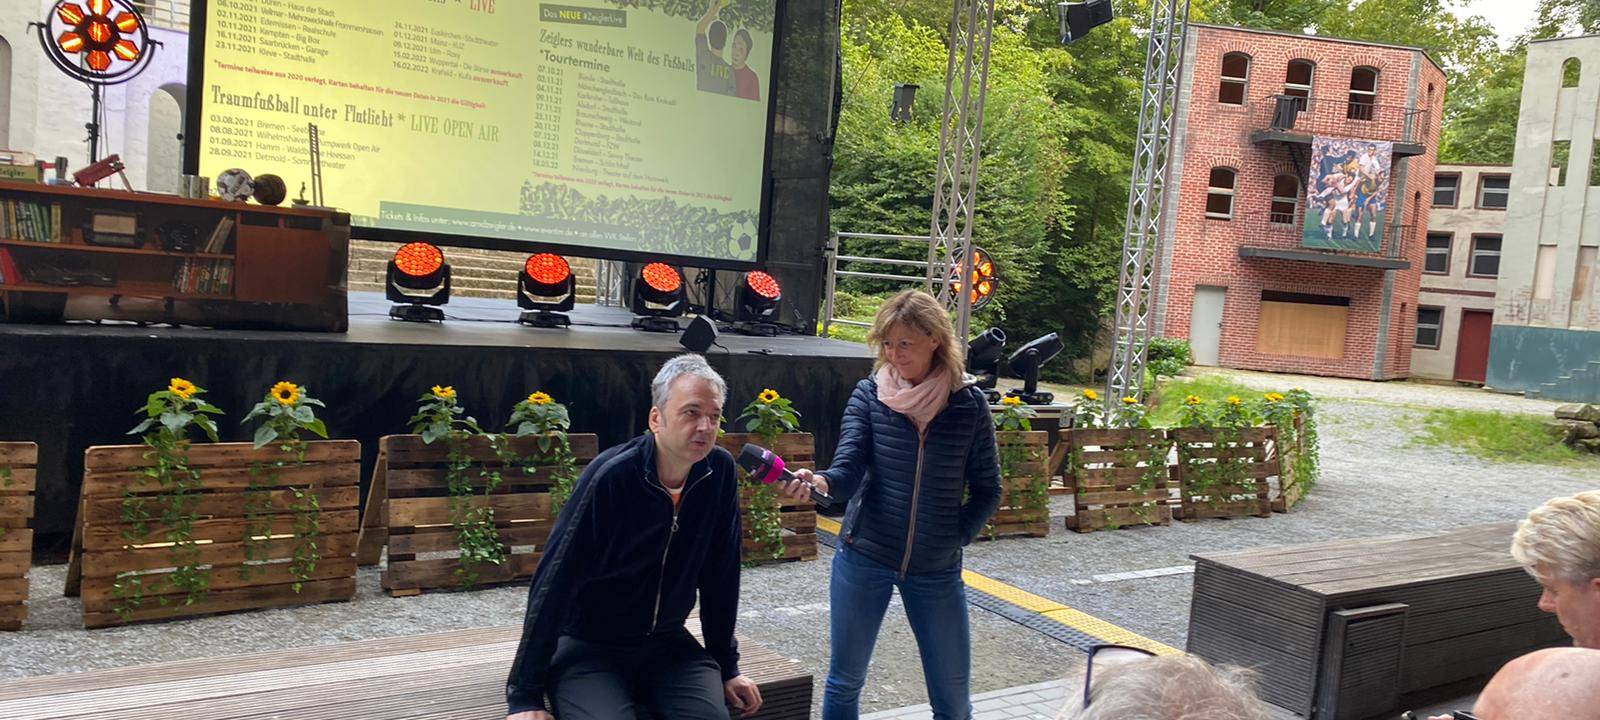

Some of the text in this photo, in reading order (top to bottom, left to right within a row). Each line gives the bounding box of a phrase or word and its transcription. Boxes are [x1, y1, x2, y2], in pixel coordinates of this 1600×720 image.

[216, 9, 257, 23] 02.11.2021
[287, 2, 304, 12] Haus
[305, 6, 317, 14] der
[318, 7, 335, 17] Stadt
[543, 9, 558, 19] Das
[559, 10, 582, 20] NEUE
[217, 20, 257, 33] 10.11.2021
[308, 35, 320, 45] Box
[393, 31, 428, 43] 01.12.2021
[215, 40, 256, 54] 23.11.2021
[259, 47, 277, 58] Kleve
[283, 51, 316, 64] Stadthalle
[259, 37, 300, 51] Saarbrücken
[306, 44, 329, 56] Garage
[393, 40, 427, 53] 09.12.2021
[539, 29, 695, 73] Zeiglers wunderbare Welt des Fußballs
[393, 61, 429, 74] 16.02.2022
[287, 72, 303, 81] 2020
[211, 84, 299, 115] Traumfußball
[303, 103, 337, 120] unter
[344, 103, 393, 127] Flutlicht
[410, 113, 439, 134] LIVE
[443, 117, 474, 139] OPEN
[478, 124, 500, 142] AIR
[210, 114, 253, 127] 03.08.2021
[257, 120, 286, 132] Bremen
[210, 125, 253, 137] 08.08.2021
[317, 138, 352, 151] umpwerk
[353, 142, 370, 153] Open
[371, 145, 380, 154] Air
[209, 136, 252, 149] 01.09.2021
[256, 142, 281, 152] Hamm
[326, 151, 356, 161] Heessen
[209, 147, 252, 159] 28.09.2021
[255, 152, 286, 163] Detmold
[0, 167, 25, 178] eigler
